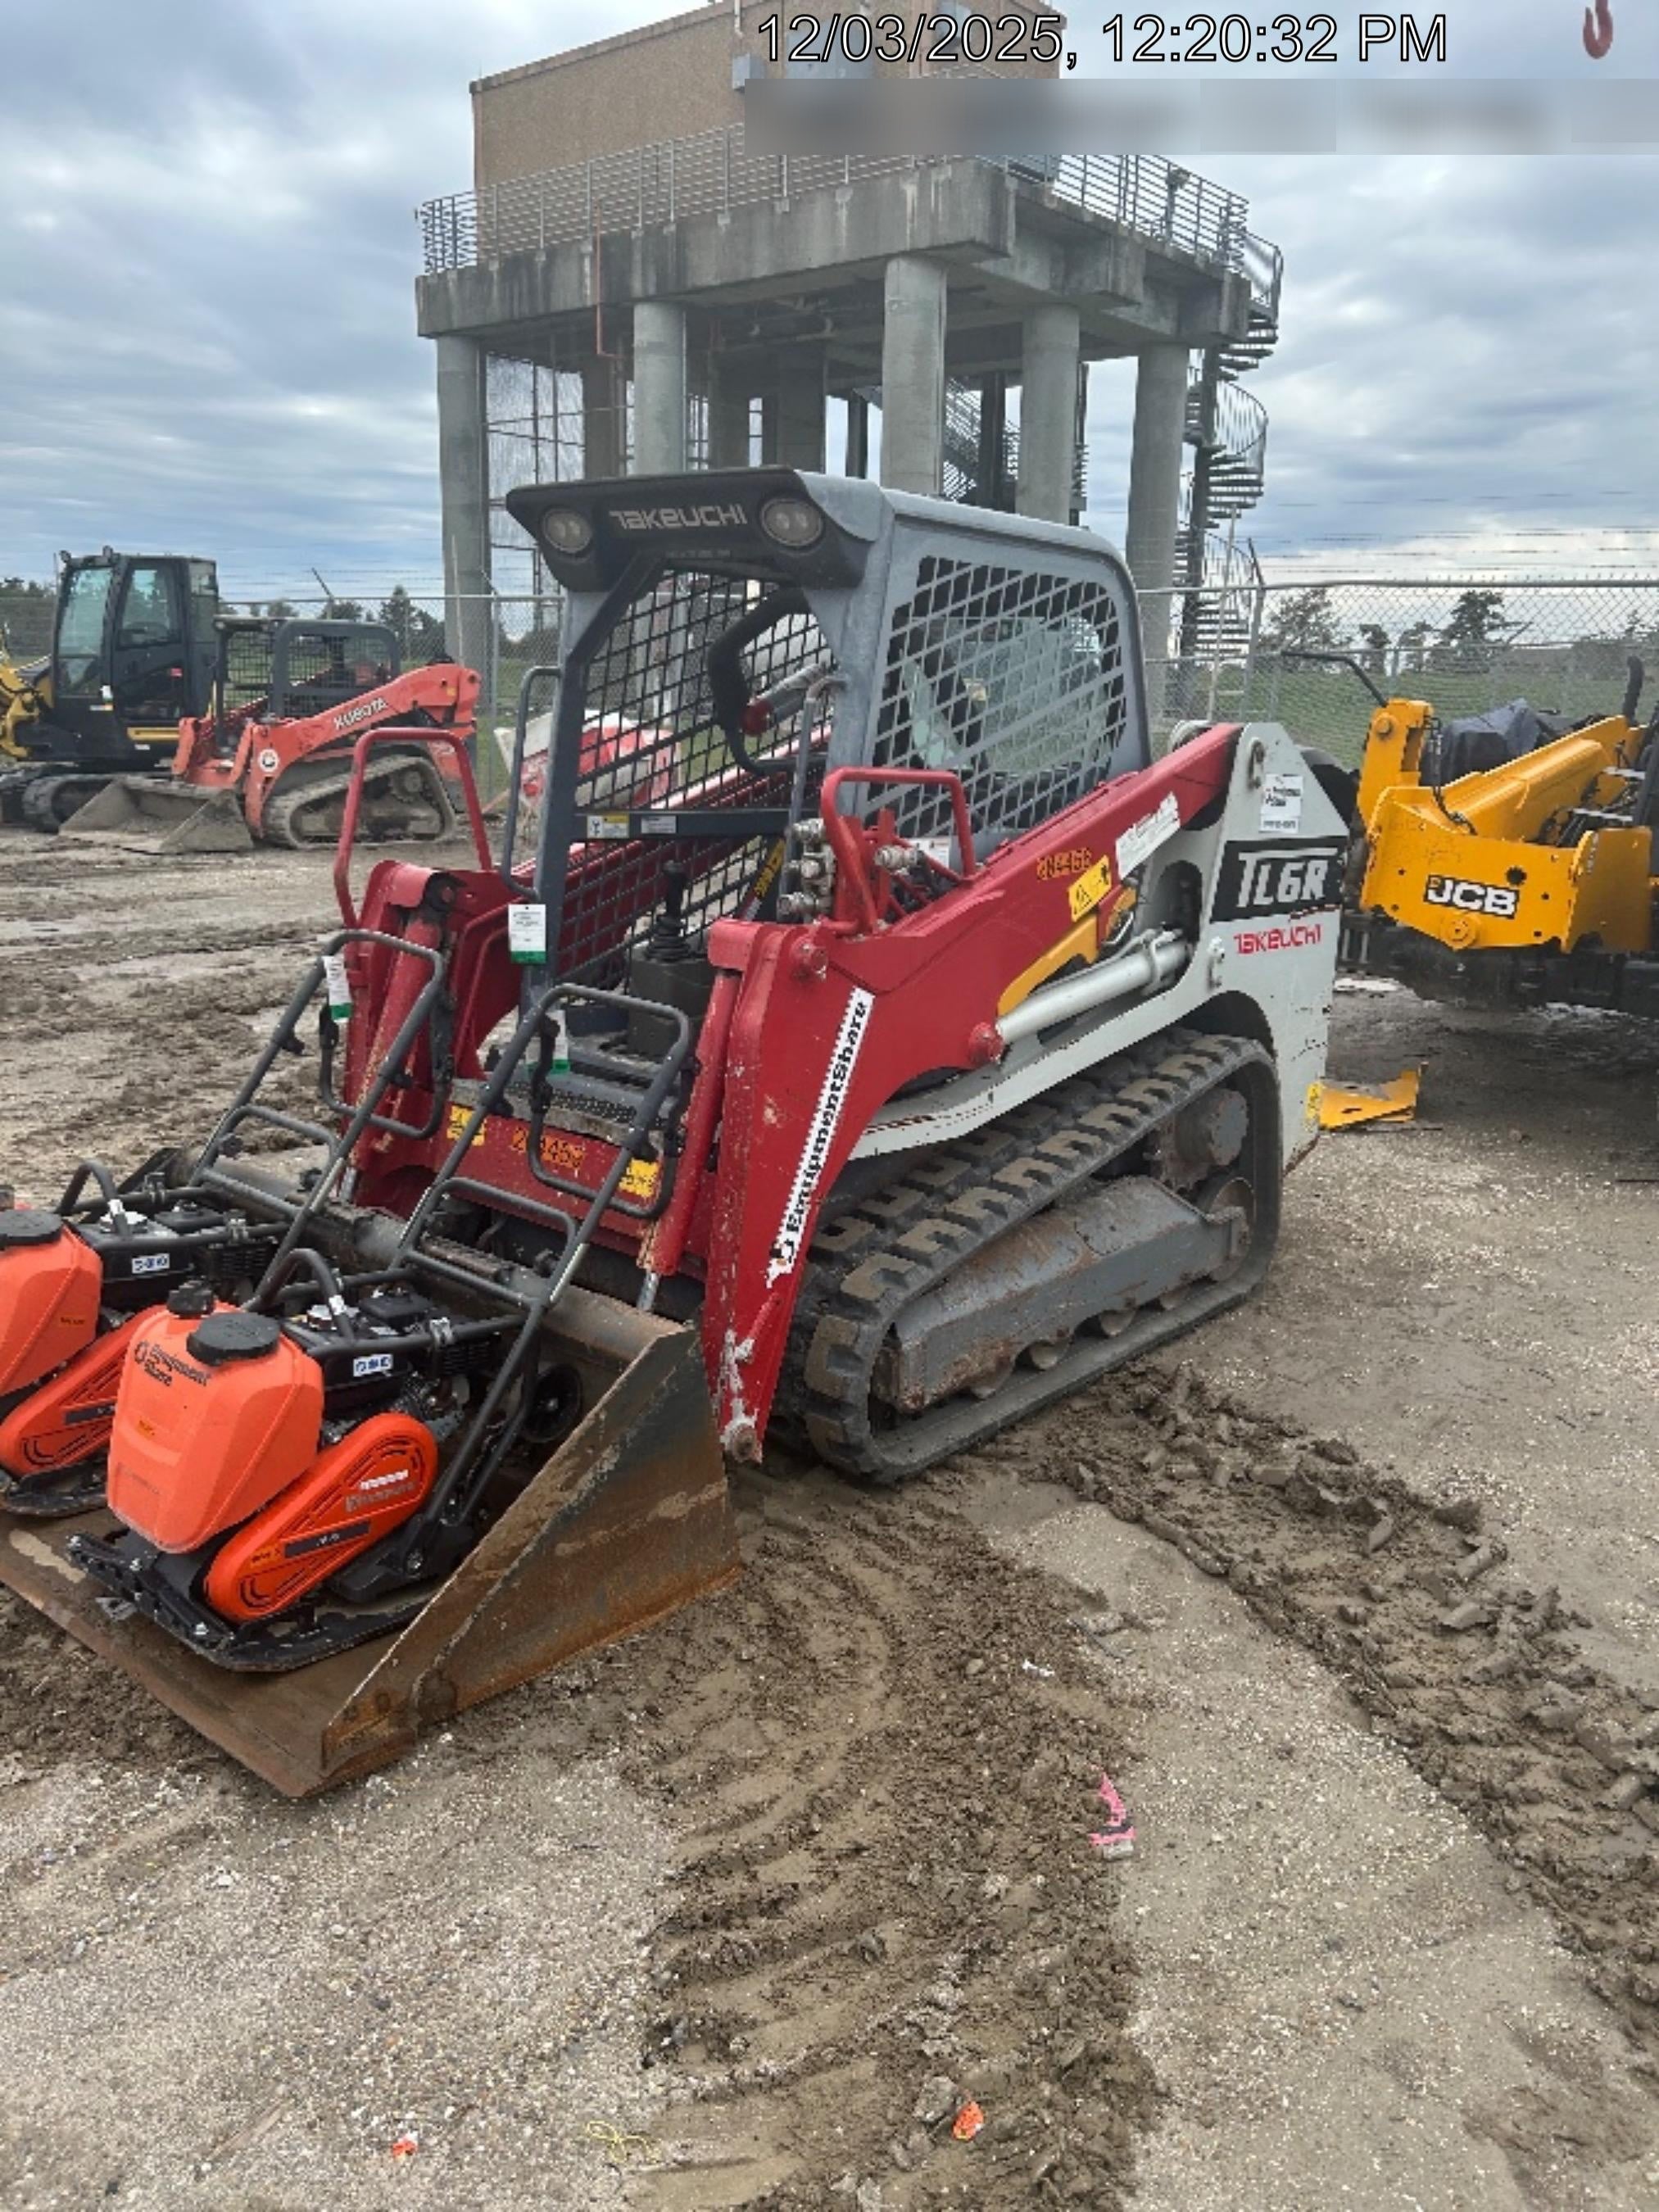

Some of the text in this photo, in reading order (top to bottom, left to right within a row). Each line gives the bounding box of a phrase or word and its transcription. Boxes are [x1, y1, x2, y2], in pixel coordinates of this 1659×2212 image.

[333, 697, 388, 730] KUBOTA
[1235, 847, 1339, 908] TL6R
[1426, 877, 1516, 916] JCB
